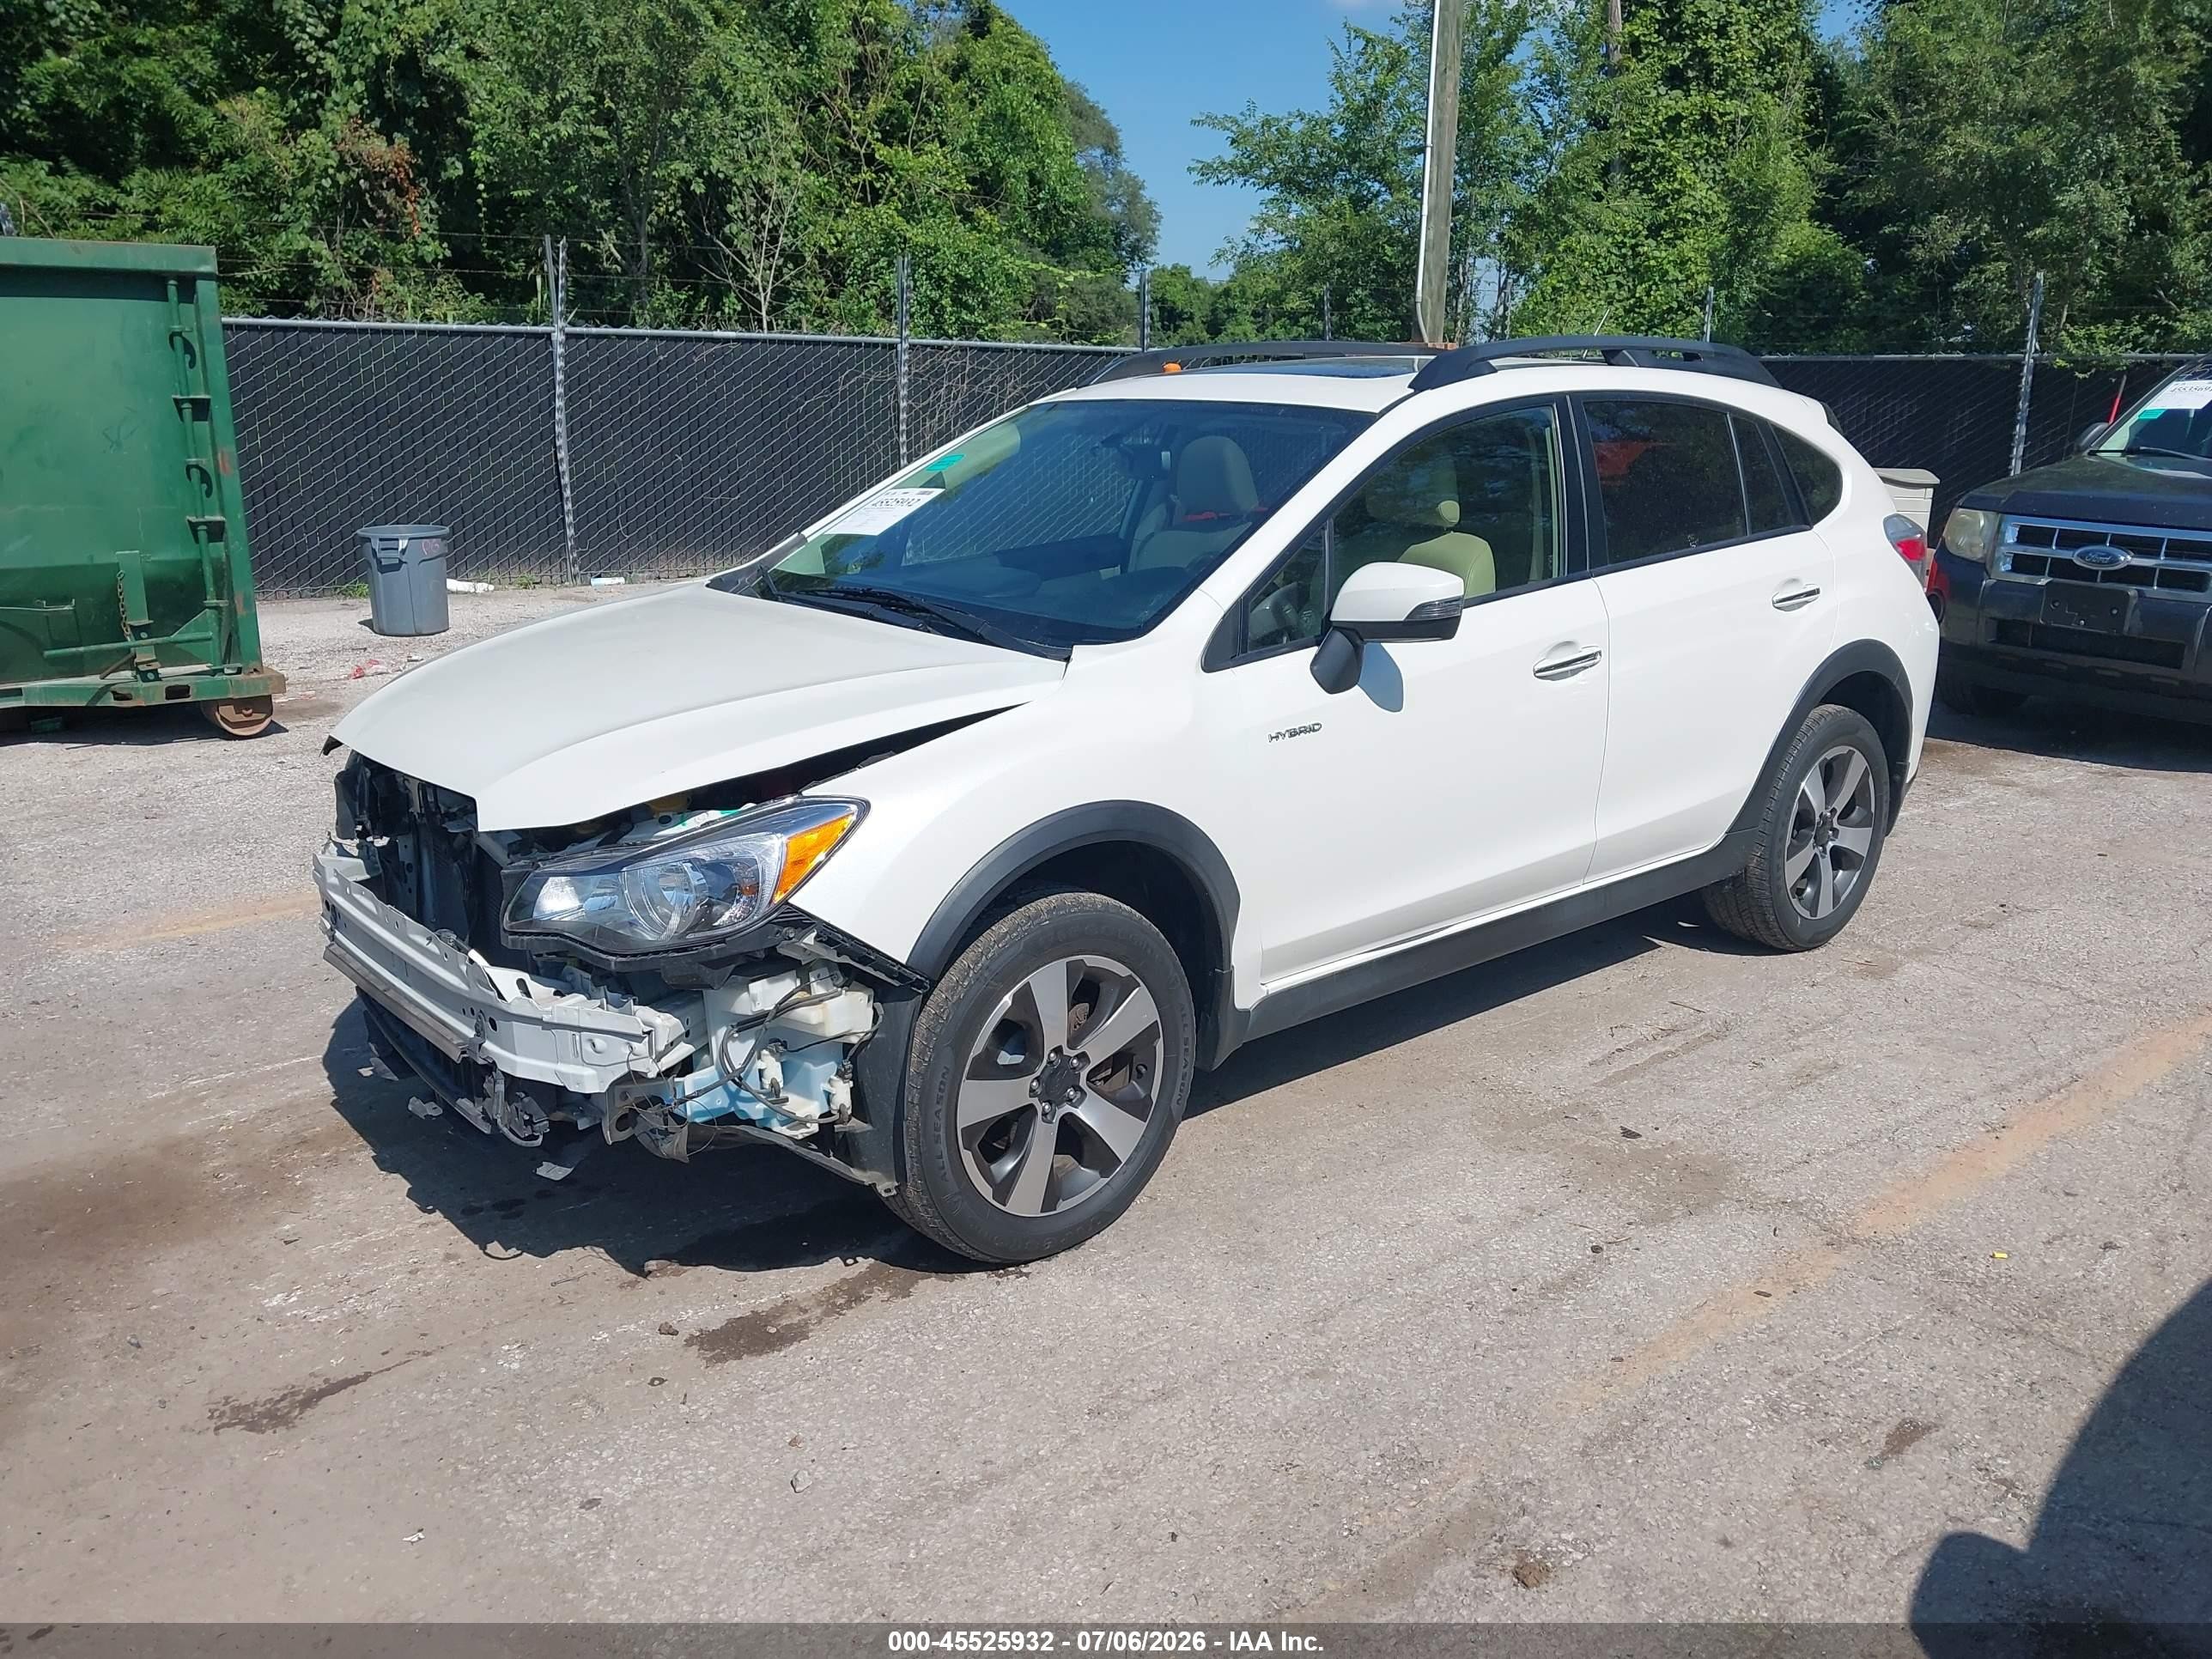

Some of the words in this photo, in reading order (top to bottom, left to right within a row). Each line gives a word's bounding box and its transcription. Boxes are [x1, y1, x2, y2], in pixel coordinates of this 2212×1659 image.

[1267, 722, 1322, 743] HYBRID
[933, 1066, 951, 1144] SEASON
[1176, 1036, 1189, 1106] SEASON
